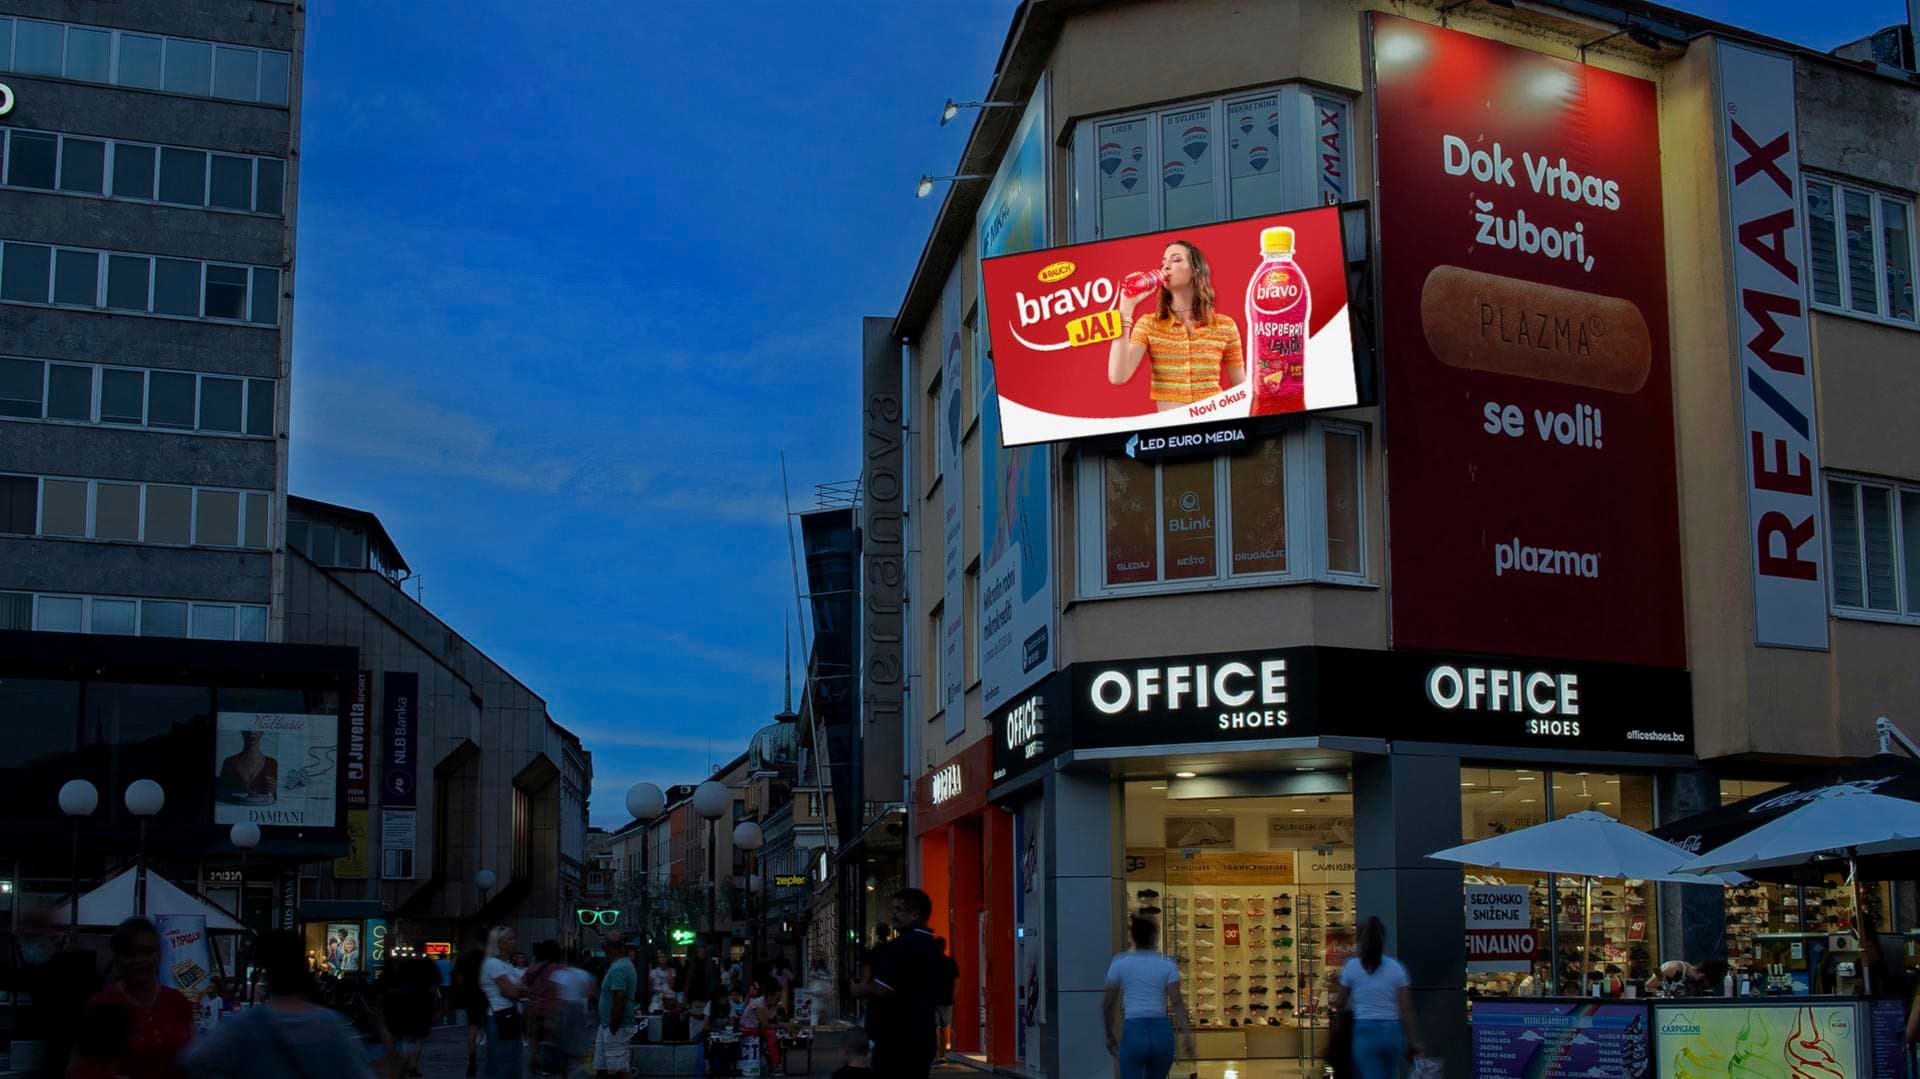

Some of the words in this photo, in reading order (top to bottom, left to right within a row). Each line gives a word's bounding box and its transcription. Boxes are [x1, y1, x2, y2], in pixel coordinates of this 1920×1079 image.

[1320, 109, 1341, 206] E/MAX
[1442, 134, 1515, 188] Dok
[1522, 152, 1621, 211] Vrbas
[1475, 199, 1596, 273] žubori,
[1047, 263, 1072, 279] RAUCH
[1016, 276, 1114, 328] bravo
[1256, 282, 1298, 301] bravo
[1075, 313, 1119, 345] JA!
[1731, 118, 1817, 581] RE/MAX
[1188, 400, 1217, 418] Novi
[1219, 388, 1247, 410] okus
[1140, 437, 1166, 451] LED
[1168, 434, 1203, 449] EURO
[1205, 429, 1246, 446] MEDIA
[1483, 401, 1525, 438] se
[1534, 402, 1604, 450] voli!
[1168, 516, 1211, 533] BLink
[869, 397, 900, 725] terranova
[1495, 537, 1599, 578] plazma
[1090, 659, 1288, 714] OFFICE
[1428, 664, 1580, 715] OFFICE
[394, 696, 408, 736] Banka
[1006, 695, 1043, 751] OFFICE
[1218, 709, 1288, 730] SHOES
[1529, 718, 1581, 736] SHOES
[348, 703, 365, 761] Juventa
[1627, 729, 1685, 742] officeshoes.ba
[395, 737, 408, 764] NLB
[248, 810, 305, 824] DAMIANI
[1273, 823, 1297, 832] CALVIN
[1297, 823, 1316, 832] KLEIN
[1311, 863, 1335, 872] CALVIN
[1470, 893, 1523, 905] SEZONSKO
[1473, 906, 1520, 920] SNIŽENJE
[373, 925, 388, 960] OVS
[1464, 934, 1535, 955] FINALNO
